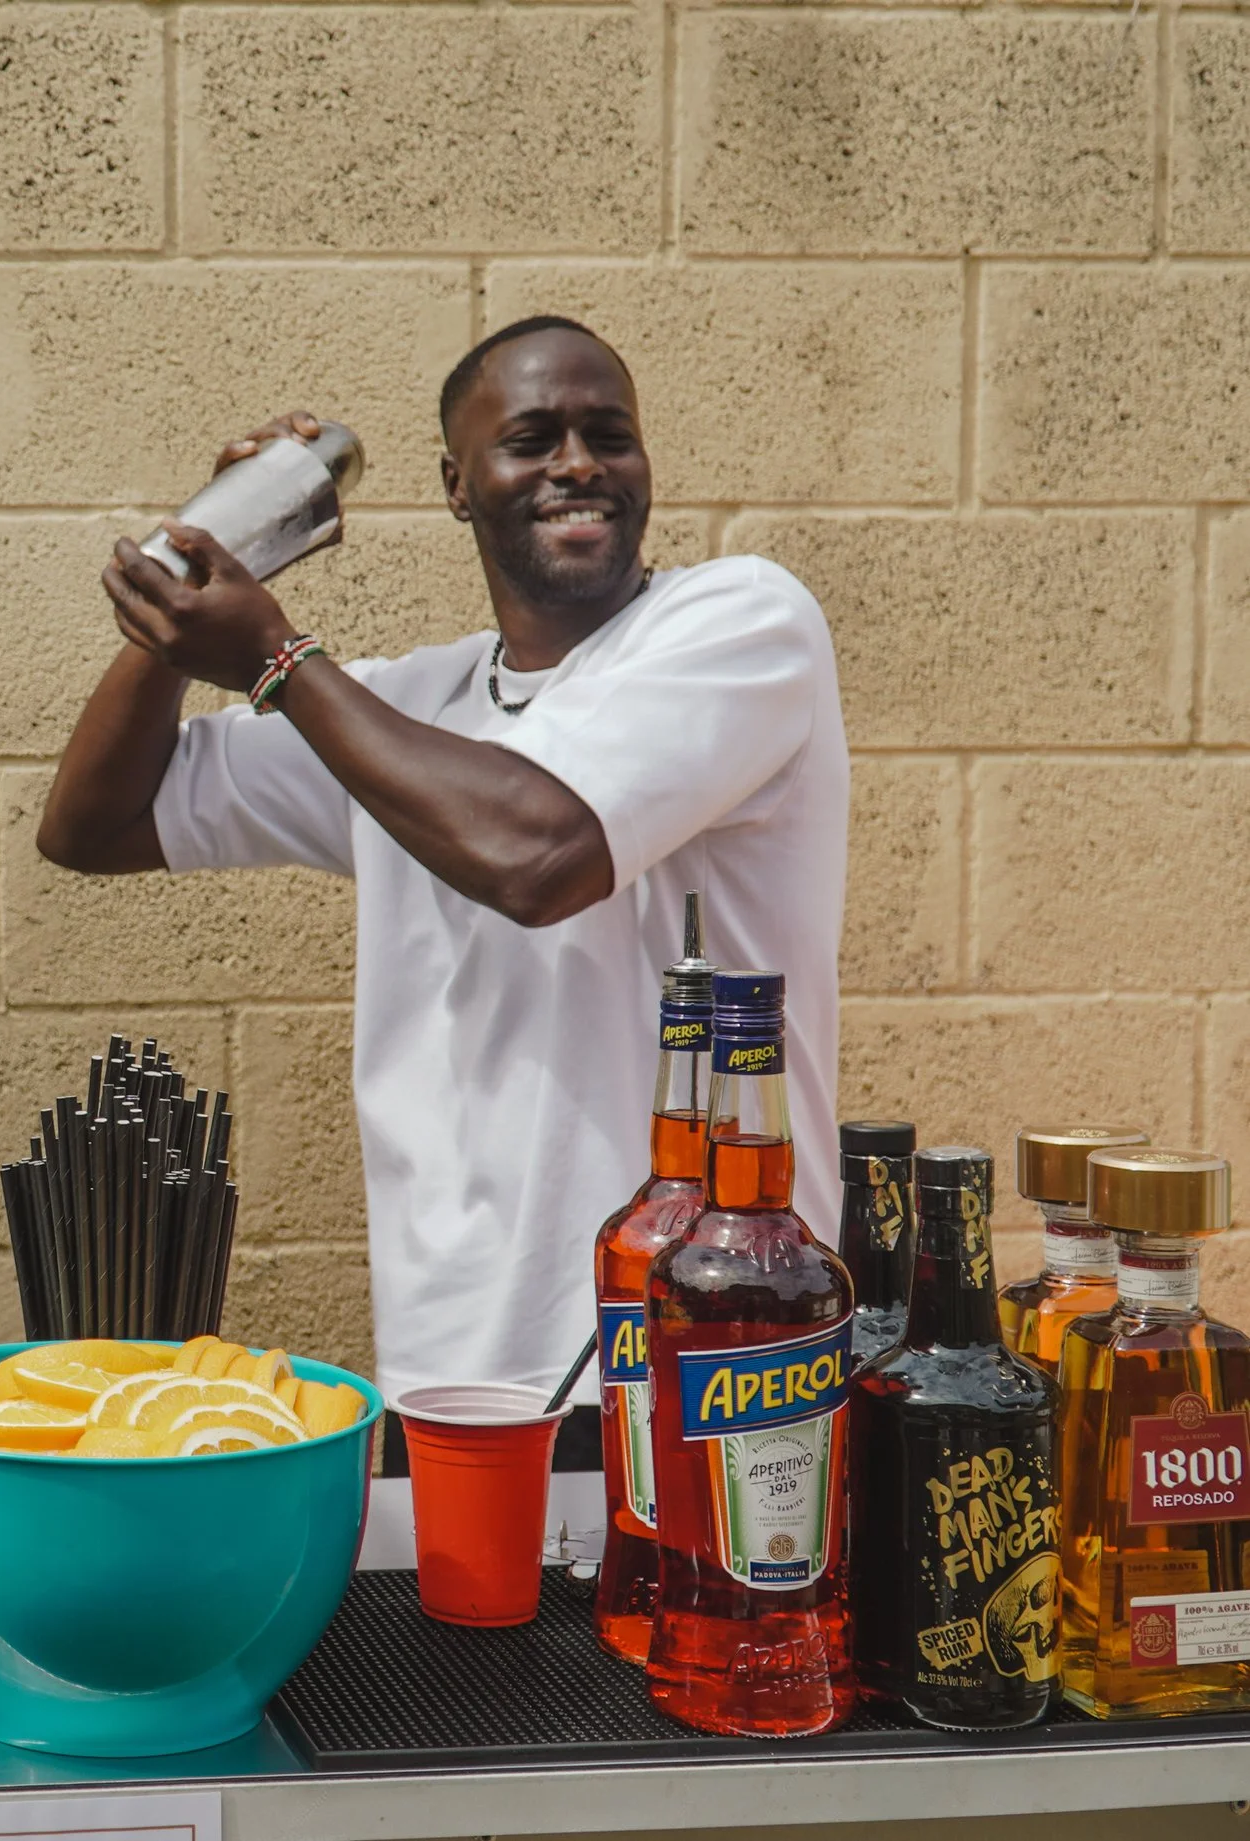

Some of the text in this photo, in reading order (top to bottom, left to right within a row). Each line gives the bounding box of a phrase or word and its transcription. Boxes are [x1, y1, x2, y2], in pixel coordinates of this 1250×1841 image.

[663, 1023, 705, 1042] APEROL
[728, 1045, 777, 1067] APEROL
[868, 1156, 904, 1251] DMF
[959, 1186, 991, 1289] DMF
[700, 1349, 845, 1422] APEROL
[752, 1435, 810, 1454] RICETTA ORIGINALE
[748, 1452, 813, 1479] APERITIVO
[1141, 1445, 1242, 1489] 1800
[769, 1480, 797, 1497] 1919
[774, 1474, 792, 1483] DAL
[925, 1447, 1013, 1514] DEAD
[777, 1496, 806, 1512] BARBIERI
[1153, 1491, 1235, 1507] REPOSADO
[939, 1475, 1033, 1551] MAN'S
[1185, 1603, 1250, 1615] 100% AGAVE
[922, 1622, 976, 1649] SPICED
[937, 1640, 972, 1662] RUM
